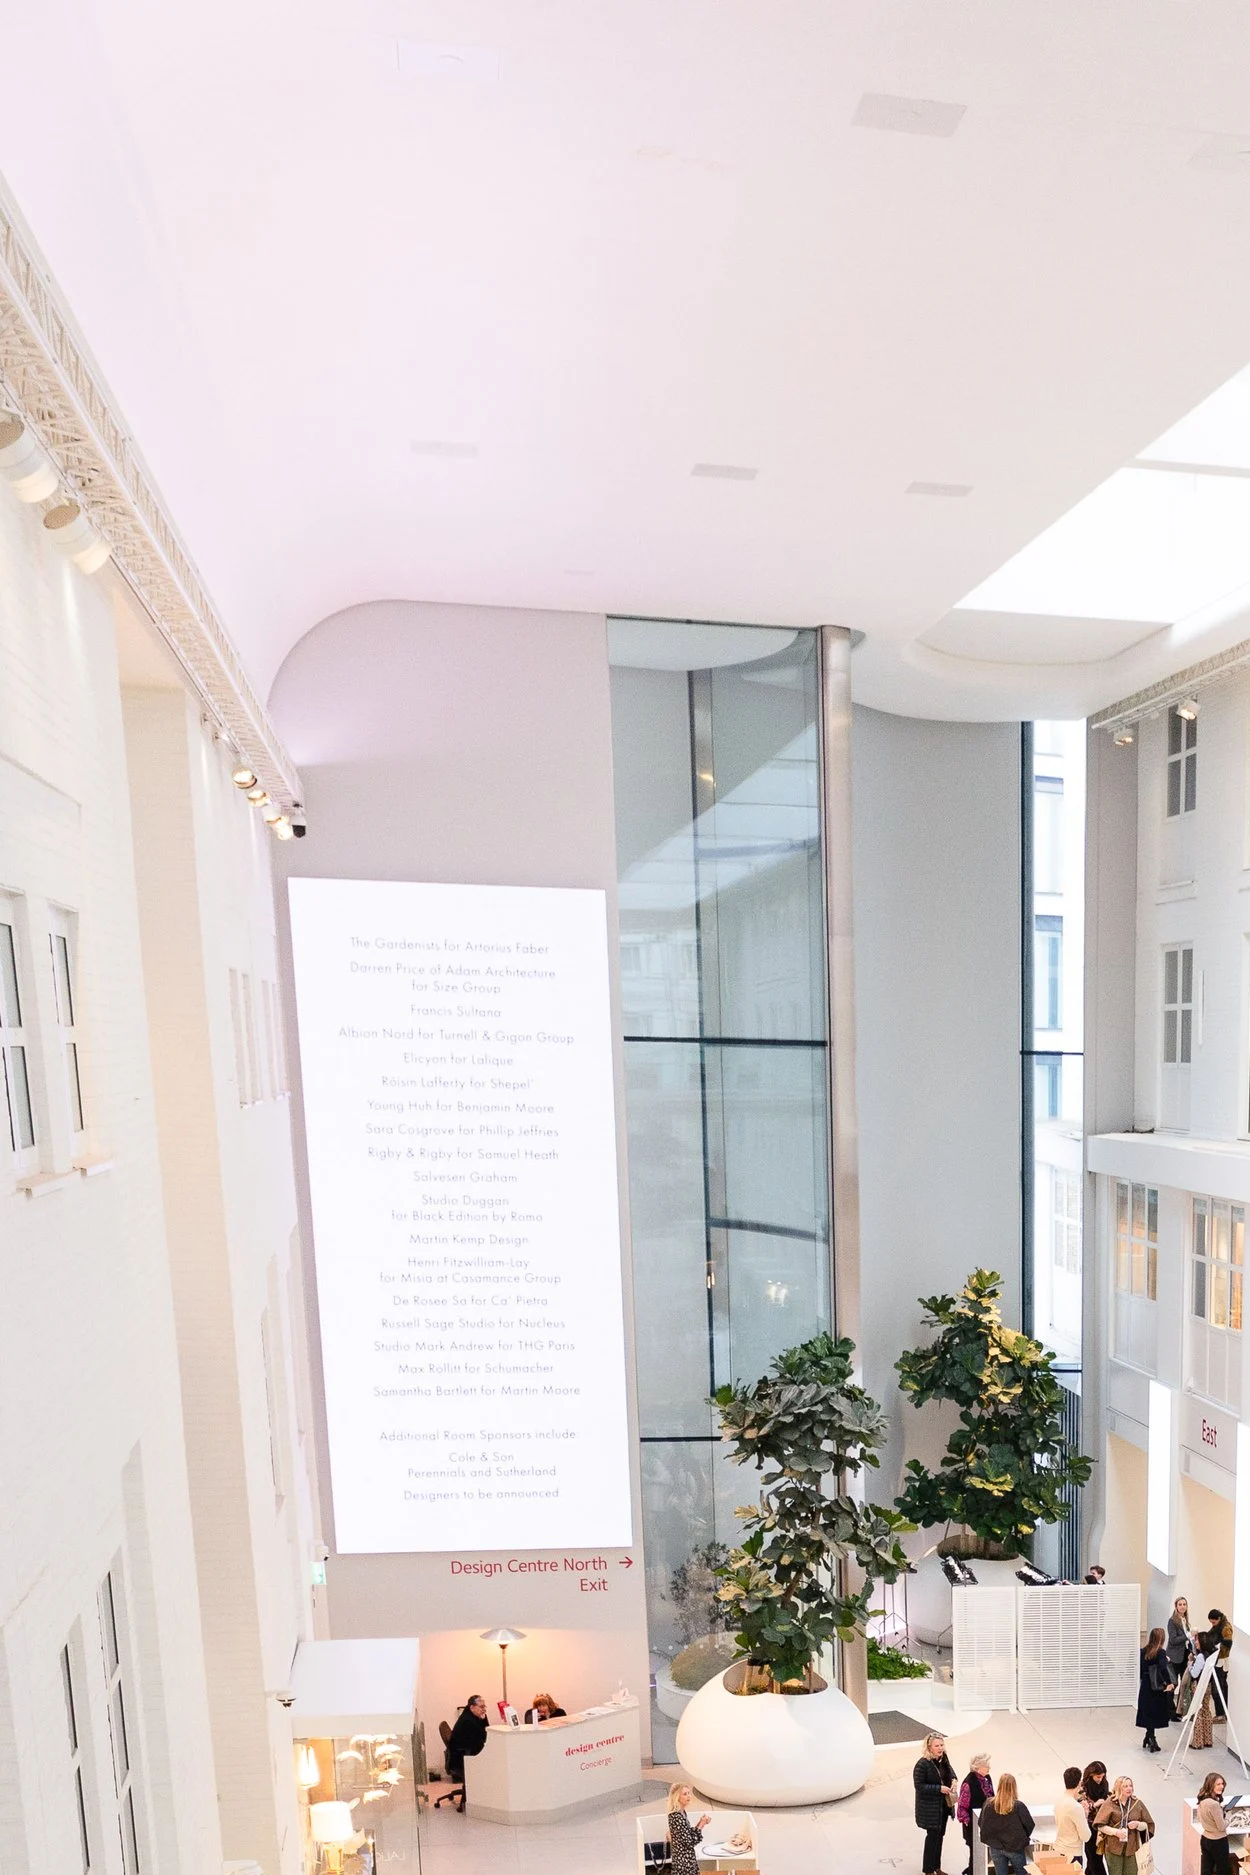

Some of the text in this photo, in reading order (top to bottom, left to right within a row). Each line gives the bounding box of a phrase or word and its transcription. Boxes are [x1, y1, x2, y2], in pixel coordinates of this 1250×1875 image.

[350, 936, 548, 954] The Gardenists for Artorius Faber
[349, 960, 556, 978] Darren Price of Adam Architecture
[411, 978, 501, 994] for Size Group
[410, 1003, 501, 1017] Francis Sultana
[338, 1026, 378, 1038] Albion
[381, 1027, 414, 1039] Nord
[417, 1026, 434, 1039] for
[481, 1029, 490, 1041] &
[535, 1031, 574, 1046] Group
[450, 1052, 466, 1064] for
[471, 1053, 513, 1067] Lalique
[420, 1075, 465, 1090] Lafferty
[469, 1077, 485, 1088] for
[366, 1099, 554, 1113] Young Huh for Benjamin Moore
[365, 1122, 559, 1137] Sara Cosgrove for Phillip Jeffries
[367, 1146, 559, 1161] Rigby & Rigby for Samuel Heath
[413, 1170, 517, 1182] Salvesen Graham
[421, 1193, 509, 1208] Studio Duggan
[390, 1209, 407, 1220] for
[411, 1209, 444, 1221] Black
[447, 1209, 488, 1221] Edition
[491, 1210, 506, 1224] by
[408, 1233, 528, 1247] Martin Kemp Design
[379, 1271, 395, 1283] for
[436, 1274, 448, 1283] at
[523, 1272, 561, 1284] Group
[392, 1294, 409, 1306] De
[451, 1294, 467, 1305] Sa
[470, 1294, 486, 1305] for
[515, 1294, 548, 1306] Pietra
[380, 1317, 565, 1331] Russell Sage Studio for Nucleus
[373, 1338, 575, 1351] Studio Mark Andrew for THG Paris
[397, 1363, 424, 1374] Max
[463, 1362, 480, 1373] for
[484, 1361, 553, 1373] Schumacher
[372, 1384, 580, 1397] Samantha Bartlett for Martin Moore
[379, 1429, 439, 1441] Additional
[442, 1429, 475, 1440] Room
[479, 1429, 532, 1442] Sponsors
[1202, 1418, 1218, 1449] East
[448, 1451, 514, 1462] Cole & Son
[407, 1464, 556, 1479] Perennials and Sutherland
[403, 1486, 559, 1503] Designers to be announced
[450, 1556, 609, 1578] Design Centre North
[579, 1578, 609, 1592] Exit
[565, 1733, 625, 1757] design centre
[579, 1755, 613, 1772] Concierge
